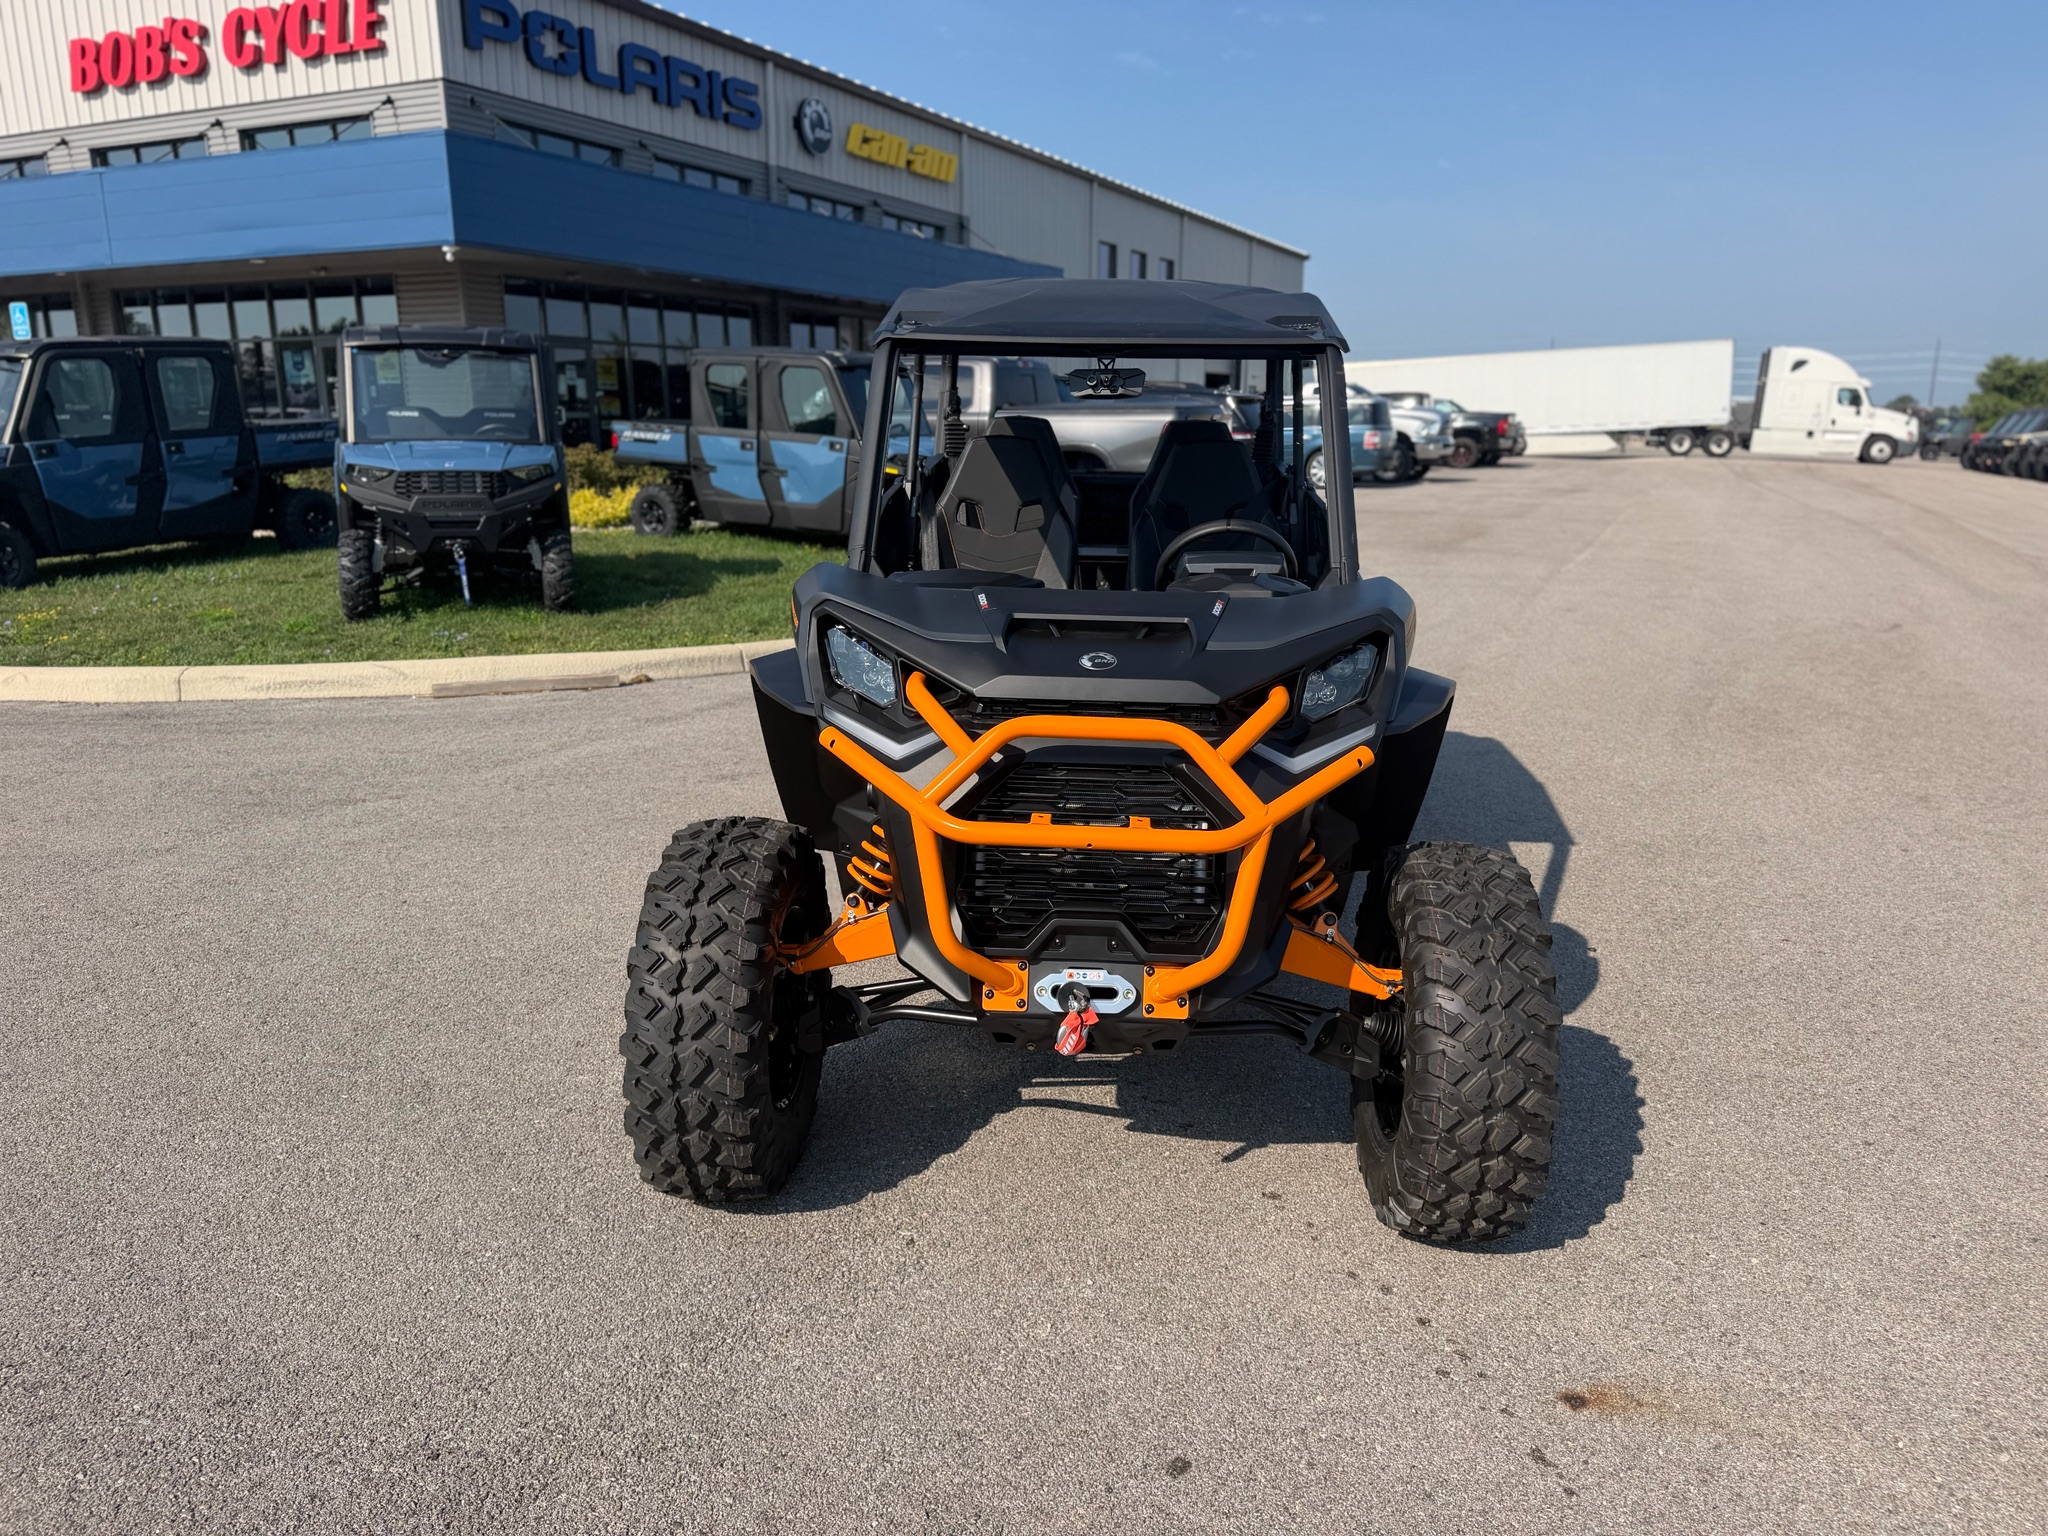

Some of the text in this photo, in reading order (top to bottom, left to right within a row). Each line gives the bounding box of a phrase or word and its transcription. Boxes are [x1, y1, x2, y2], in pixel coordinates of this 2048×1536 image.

[70, 0, 386, 93] BOB'S CYCLE
[463, 0, 762, 130] POLARIS
[276, 430, 336, 442] RANGER
[622, 430, 672, 441] RANGER
[421, 500, 485, 510] POLARIS
